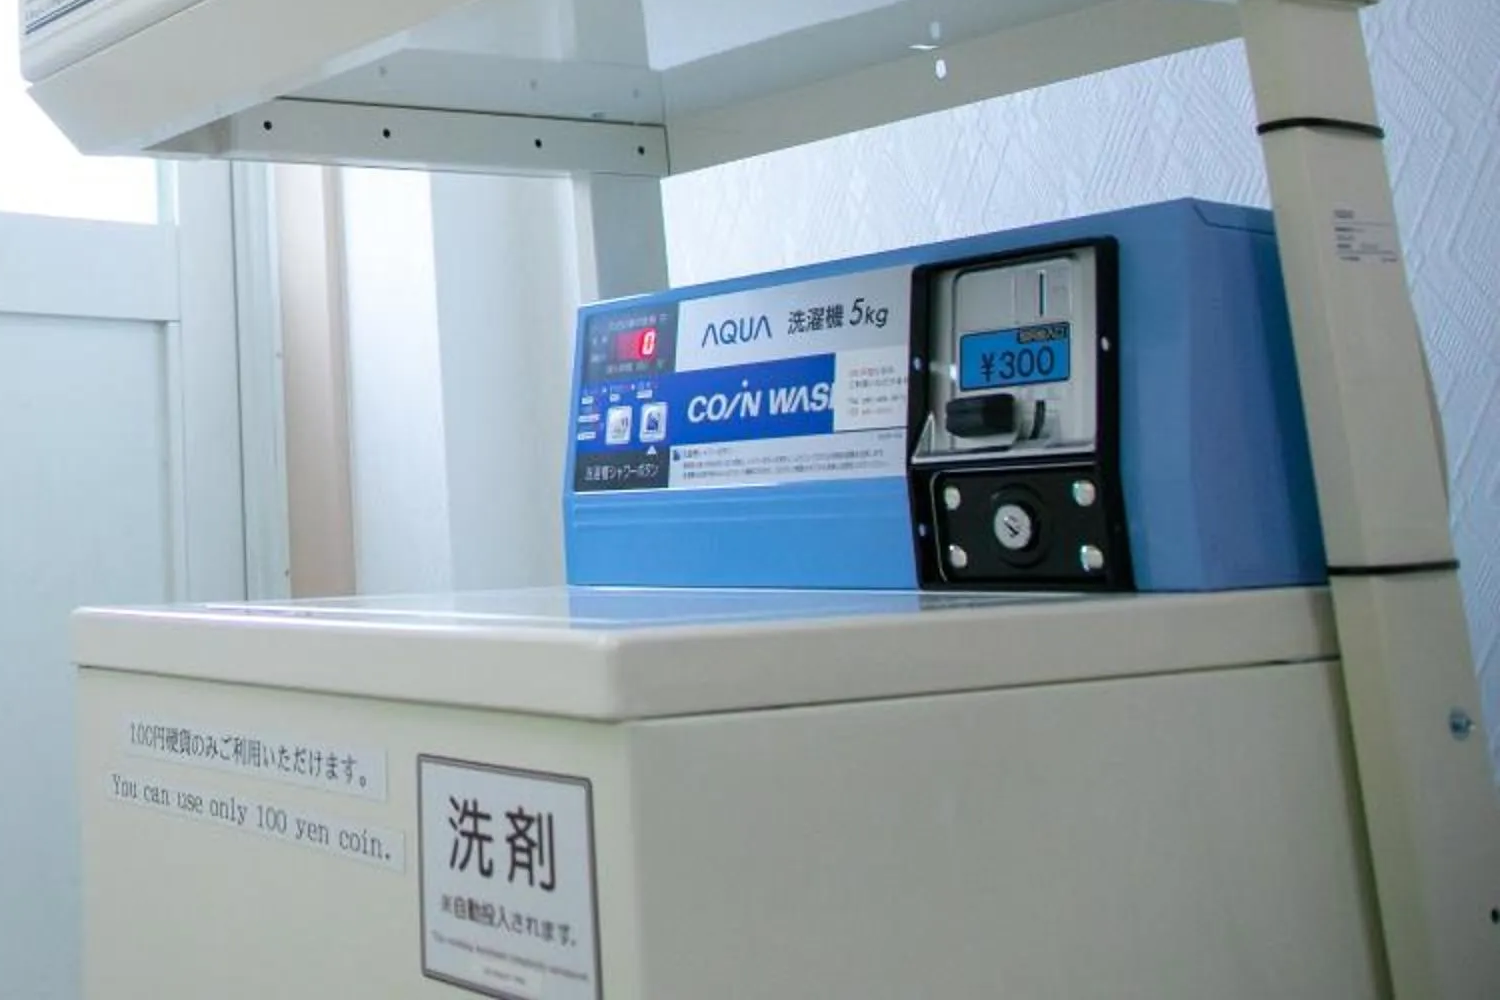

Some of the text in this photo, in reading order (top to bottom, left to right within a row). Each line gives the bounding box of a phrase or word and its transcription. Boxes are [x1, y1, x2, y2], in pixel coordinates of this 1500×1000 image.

[641, 329, 656, 356] 0
[701, 315, 772, 349] AQUA
[787, 304, 844, 335] 洗濯機
[849, 298, 889, 328] 5kg
[980, 345, 1055, 382] ¥300
[130, 722, 368, 788] 100円硬貨のみご利用いただけます。
[112, 773, 392, 860] You can use only 100 yen coin.
[448, 795, 557, 892] 洗剤
